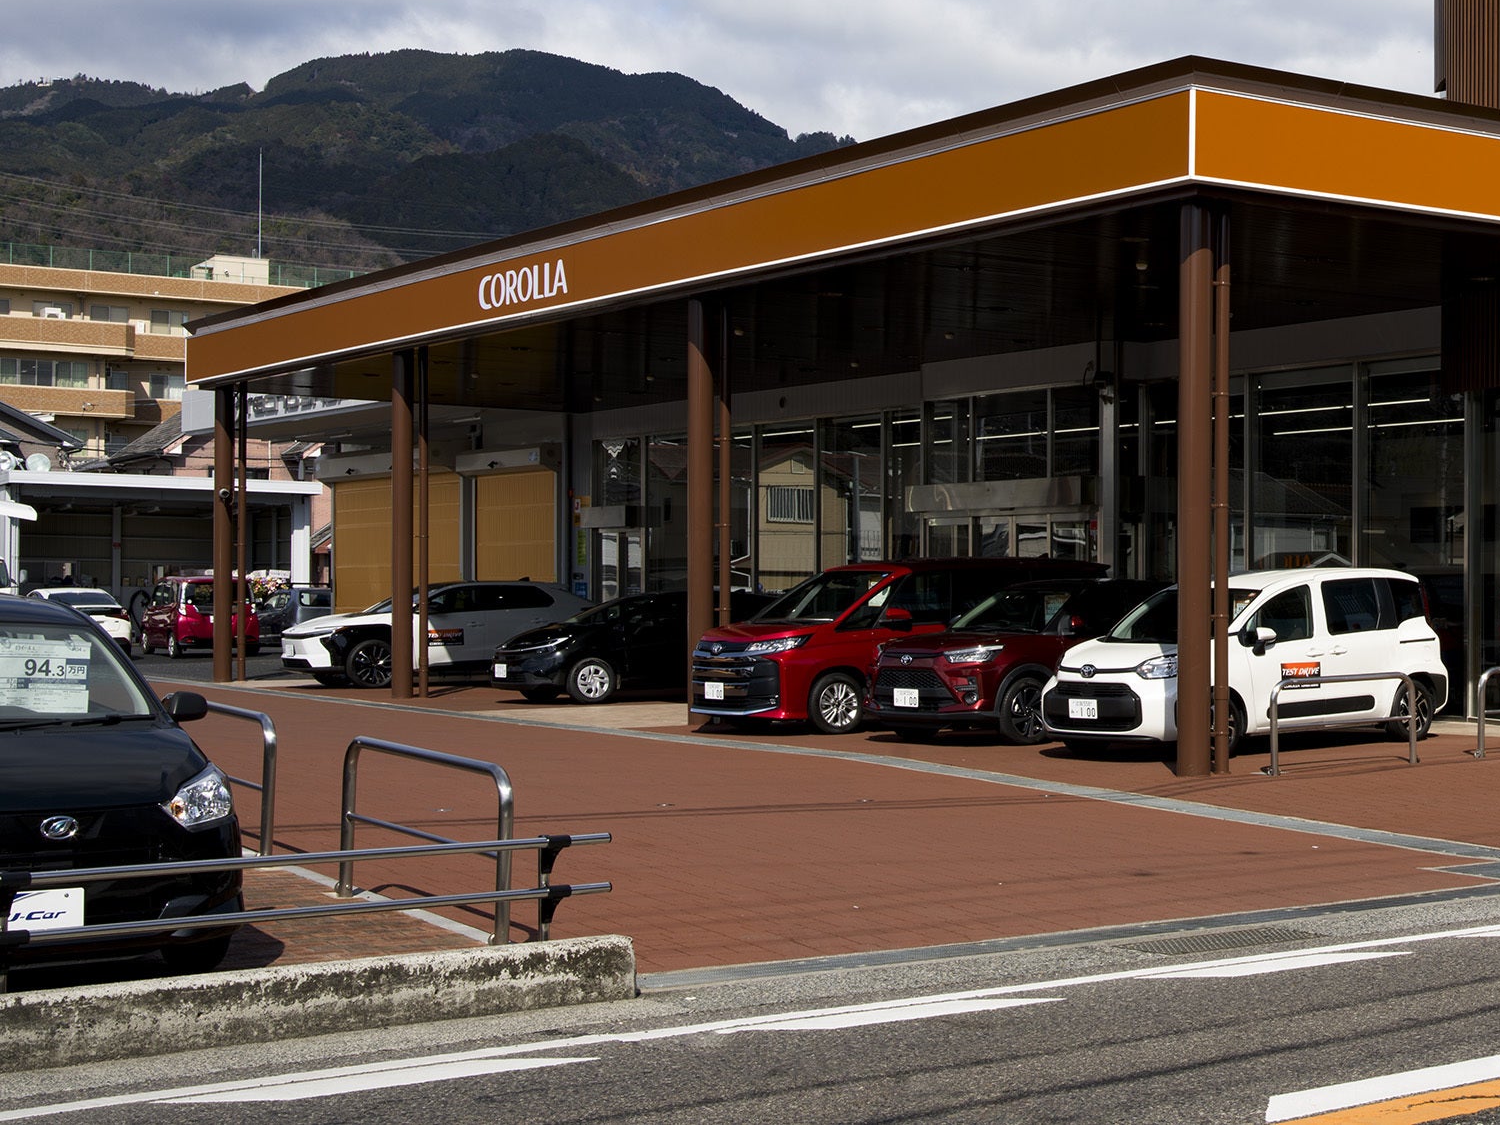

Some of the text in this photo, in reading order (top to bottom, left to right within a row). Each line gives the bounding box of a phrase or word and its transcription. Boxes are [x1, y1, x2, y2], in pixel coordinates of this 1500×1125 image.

[478, 259, 568, 310] COROLLA
[24, 658, 65, 677] 94.3
[1282, 666, 1320, 677] TEST DRIVE
